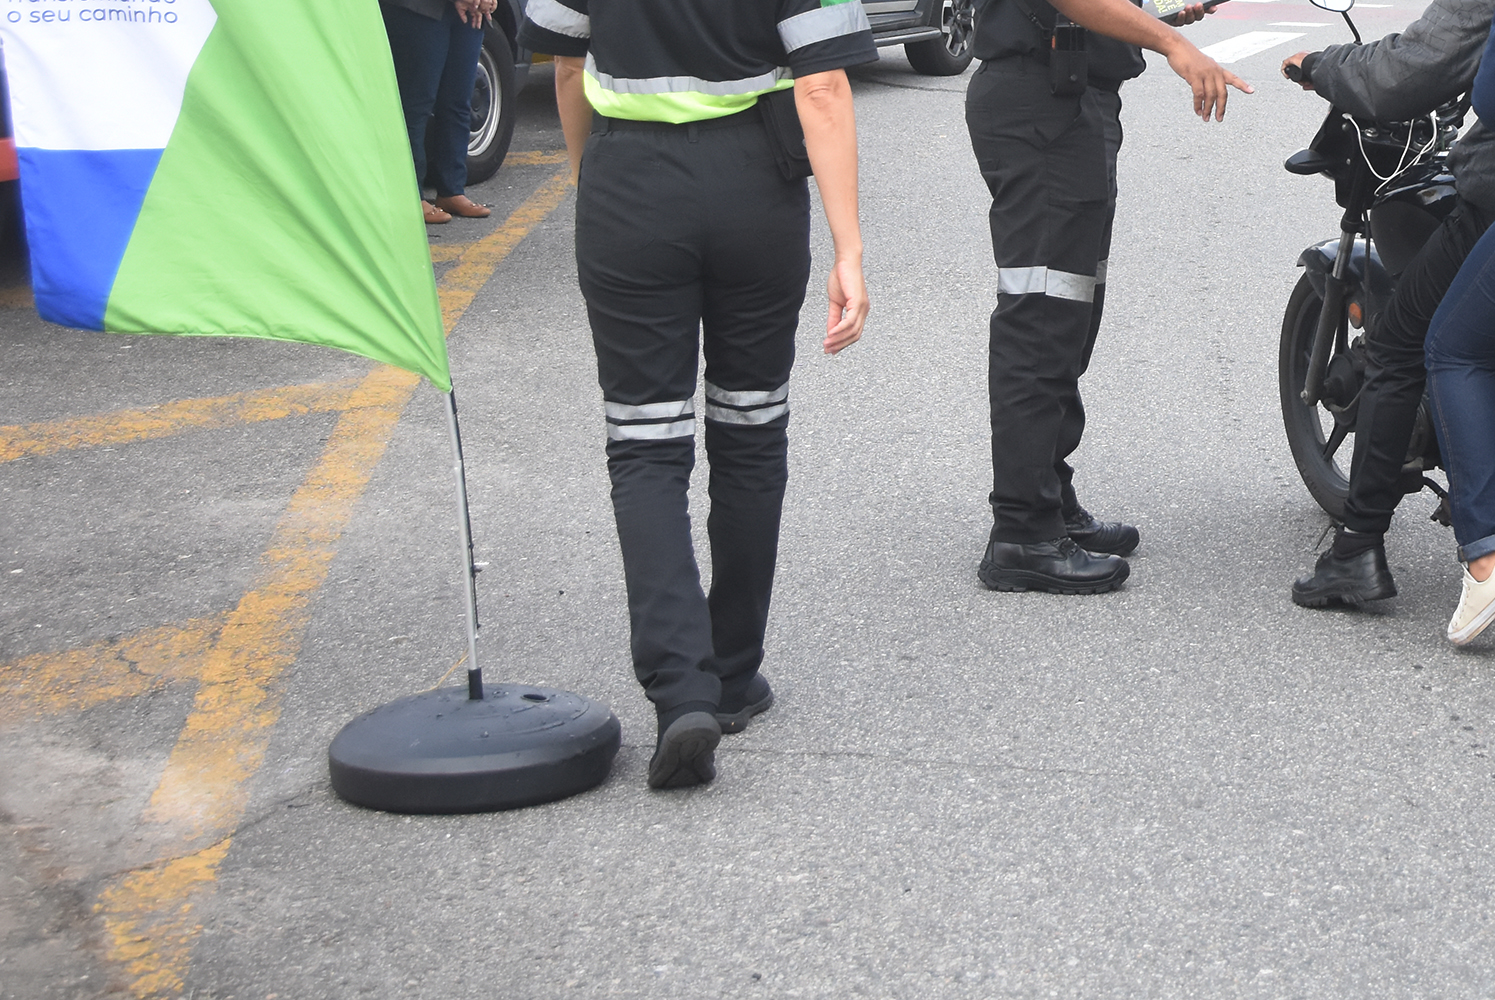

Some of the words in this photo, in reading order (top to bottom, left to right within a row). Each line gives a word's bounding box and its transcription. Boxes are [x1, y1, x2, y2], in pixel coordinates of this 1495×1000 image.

[7, 10, 22, 23] o
[29, 9, 70, 23] seu
[79, 6, 178, 23] caminho
